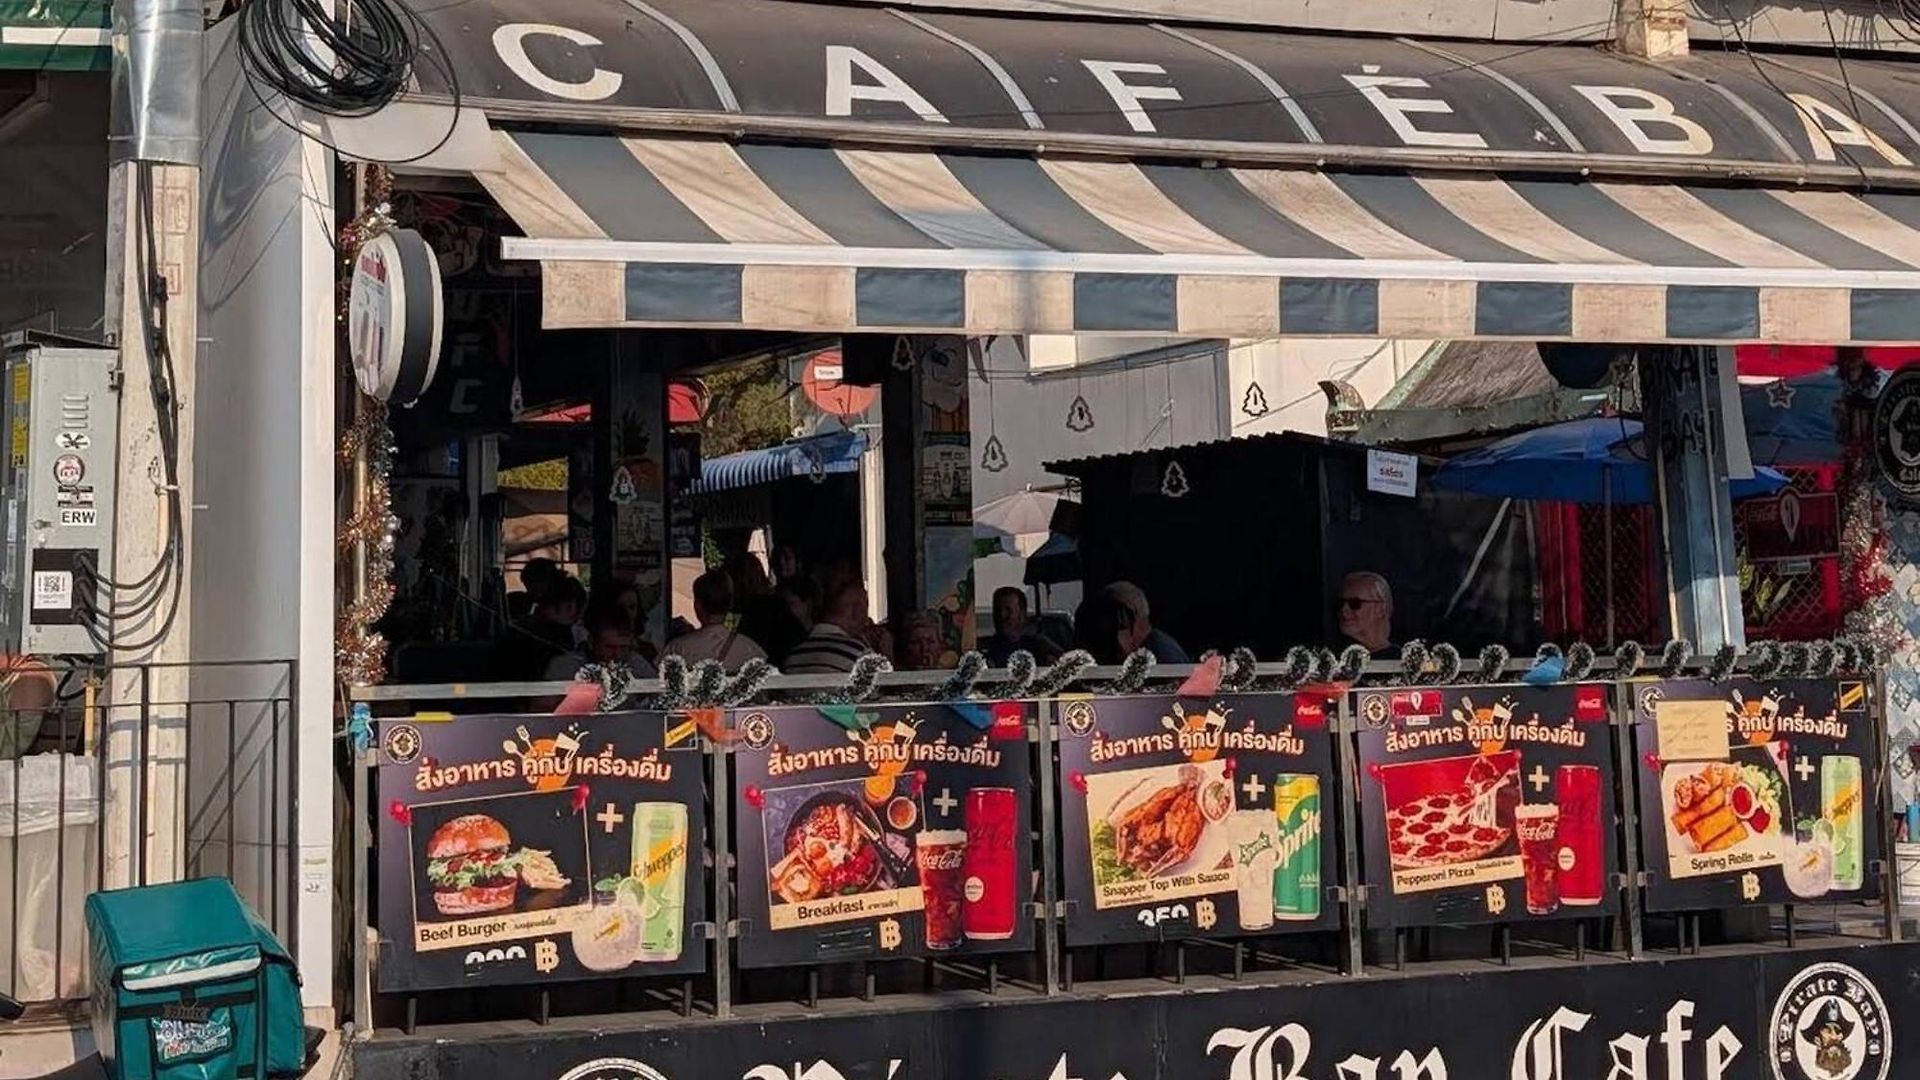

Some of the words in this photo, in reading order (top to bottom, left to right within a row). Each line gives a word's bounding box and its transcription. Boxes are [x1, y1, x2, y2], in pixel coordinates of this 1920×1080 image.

[62, 511, 95, 523] ERW
[1386, 724, 1463, 752] สั่งอาหาร
[1511, 713, 1585, 747] เครื่องดื่ม
[1778, 706, 1848, 739] เครื่องดื่ม
[768, 741, 858, 775] สั่งอาหาร
[914, 732, 1000, 767] เครื่องดื่ม
[1091, 732, 1173, 763] สั่งอาหาร
[1225, 720, 1304, 754] เครื่องดื่ม
[415, 755, 515, 791] สั่งอาหาร
[577, 743, 672, 781] เครื่องดื่ม
[1691, 856, 1726, 871] Spring
[1728, 852, 1754, 865] Rolls
[1103, 884, 1146, 897] Snapper
[1150, 880, 1169, 890] Top
[1171, 876, 1195, 887] With
[1198, 872, 1229, 884] Sauce
[1397, 870, 1446, 886] Pepperoni
[1448, 868, 1475, 878] Pizza
[797, 900, 864, 919] Breakfast
[421, 928, 453, 942] Beef
[458, 922, 507, 939] Burger
[1779, 978, 1838, 1042] Pirate
[1843, 978, 1879, 1035] Bay
